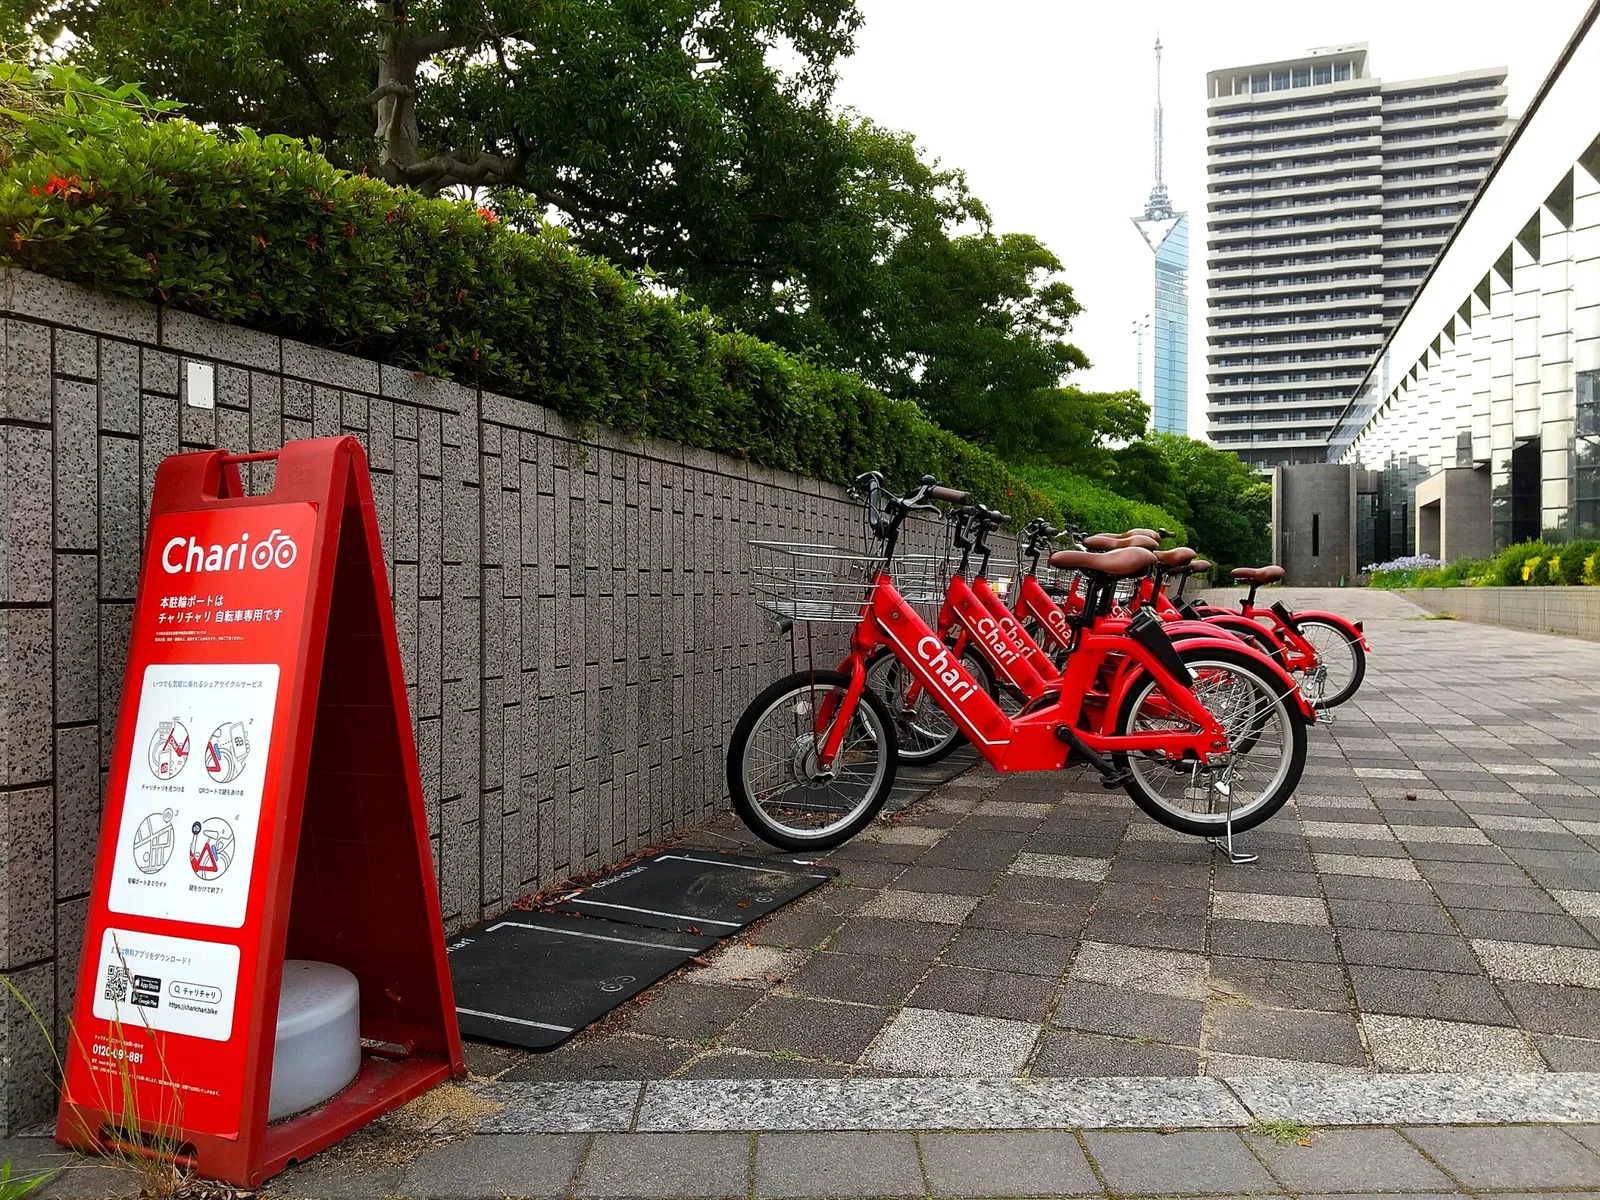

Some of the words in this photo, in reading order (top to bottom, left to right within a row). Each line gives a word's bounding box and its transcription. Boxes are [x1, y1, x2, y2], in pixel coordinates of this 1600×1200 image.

[162, 532, 249, 574] Chari
[158, 611, 211, 624] チャリチャリ
[215, 608, 283, 623] 自転車専用です
[160, 595, 224, 609] 本駐輪ポートは
[998, 617, 1037, 660] Chari
[1048, 610, 1072, 641] Cha
[977, 617, 1020, 666] Chari
[917, 636, 978, 702] Chari
[183, 987, 216, 999] チャリチャリ
[92, 1043, 144, 1064] 0120-09-881
